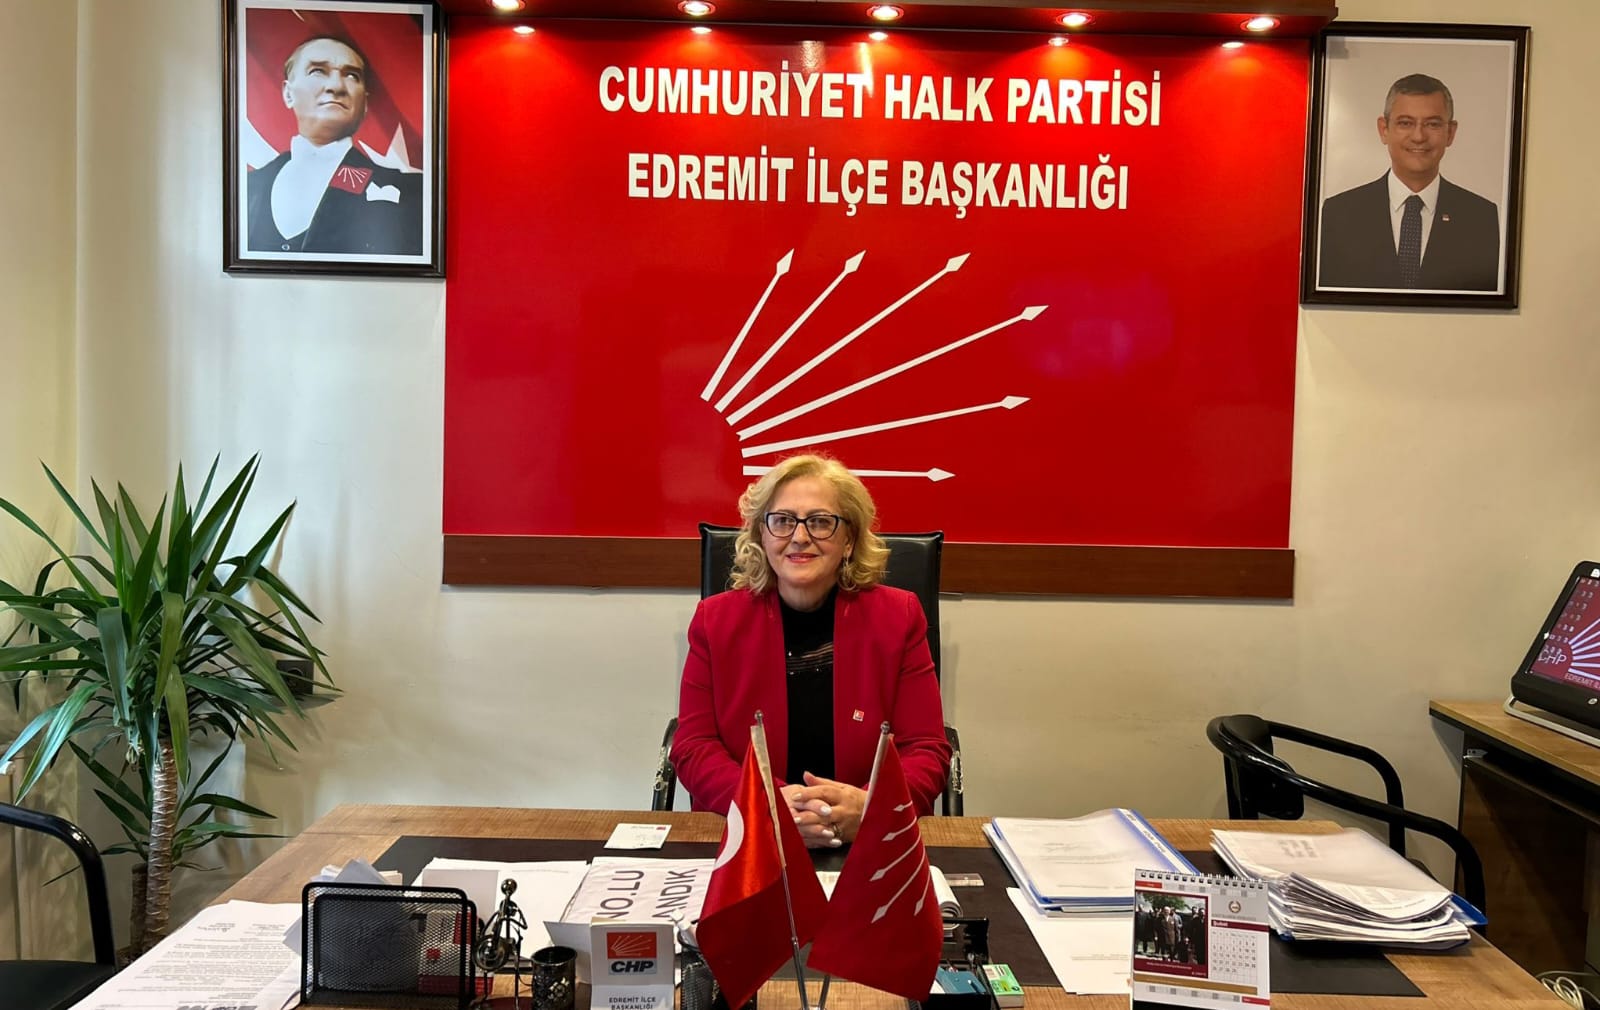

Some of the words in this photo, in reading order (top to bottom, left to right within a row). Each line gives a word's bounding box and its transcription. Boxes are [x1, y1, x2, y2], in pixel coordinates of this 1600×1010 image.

[599, 60, 869, 118] CUMHURİYET
[884, 74, 994, 122] HALK
[1007, 69, 1161, 126] PARTİSİ
[628, 145, 793, 202] EDREMİT
[807, 146, 888, 216] İLÇE
[901, 153, 1128, 219] BAŞKANLIĞI
[1538, 650, 1567, 665] CHP
[611, 960, 654, 973] CHP
